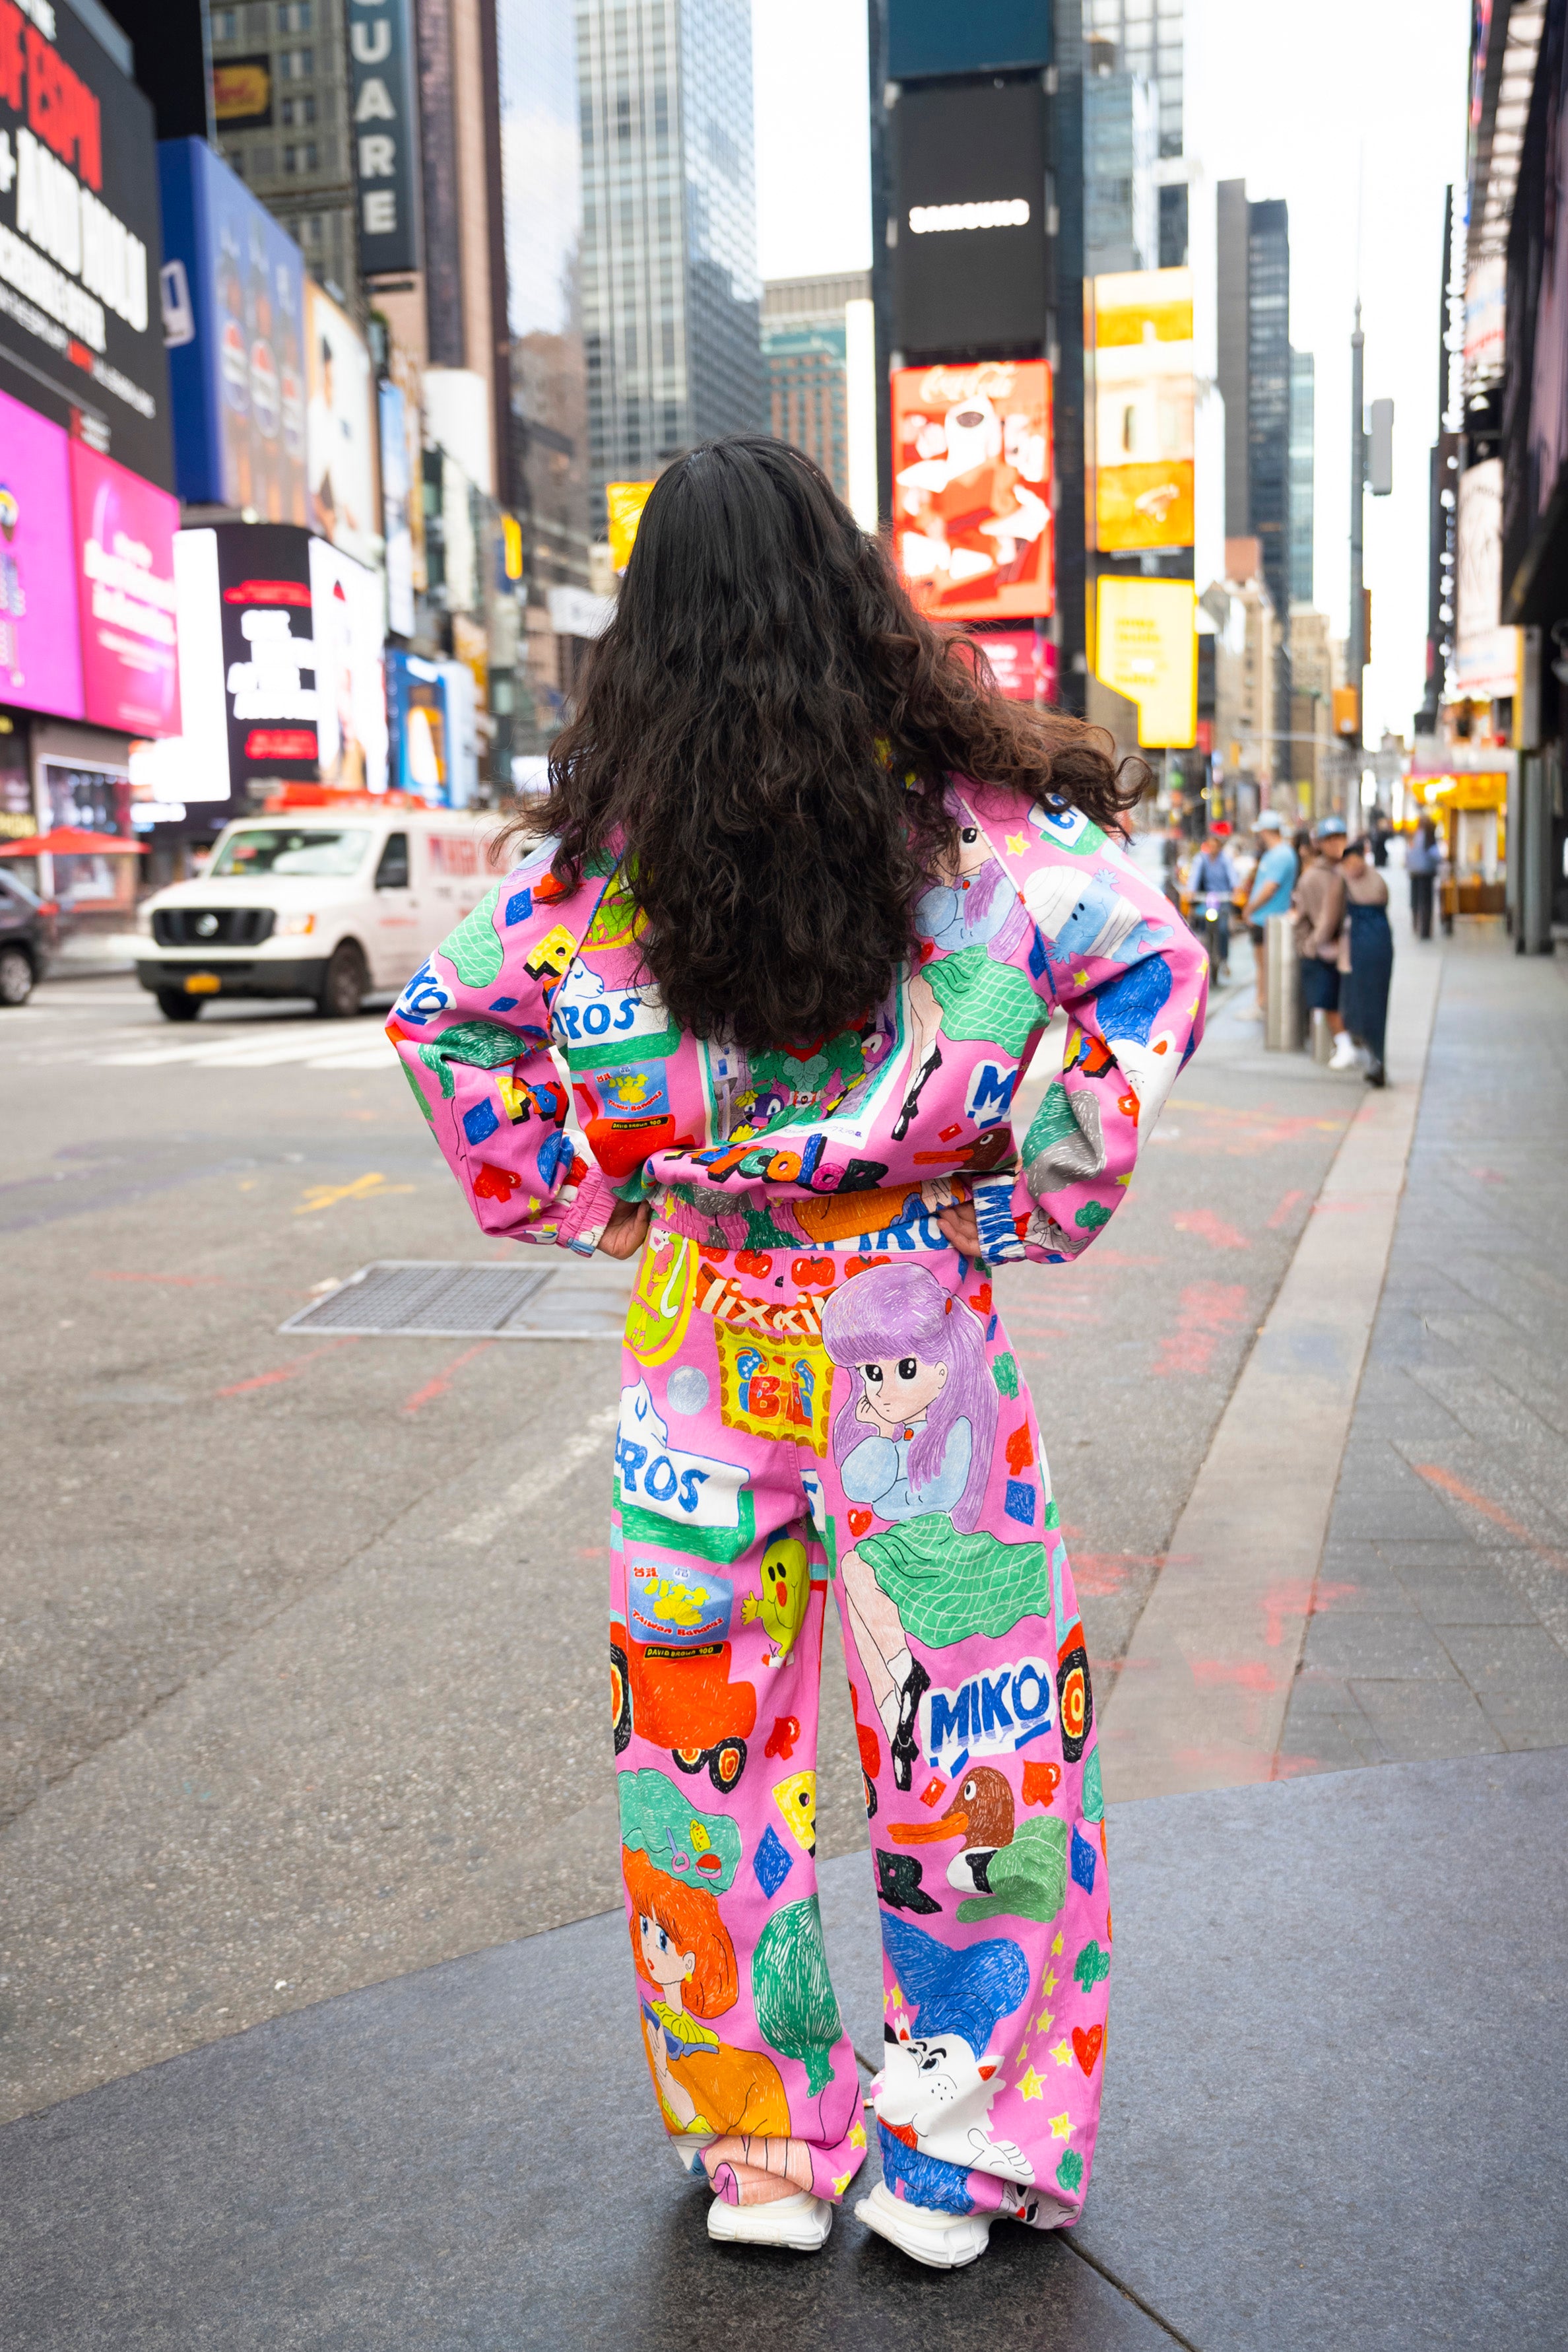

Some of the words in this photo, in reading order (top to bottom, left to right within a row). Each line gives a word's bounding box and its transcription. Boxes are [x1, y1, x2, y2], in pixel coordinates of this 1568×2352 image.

[350, 0, 397, 234] UARE
[615, 1419, 711, 1513] ROS
[930, 1663, 1051, 1754] MIKO
